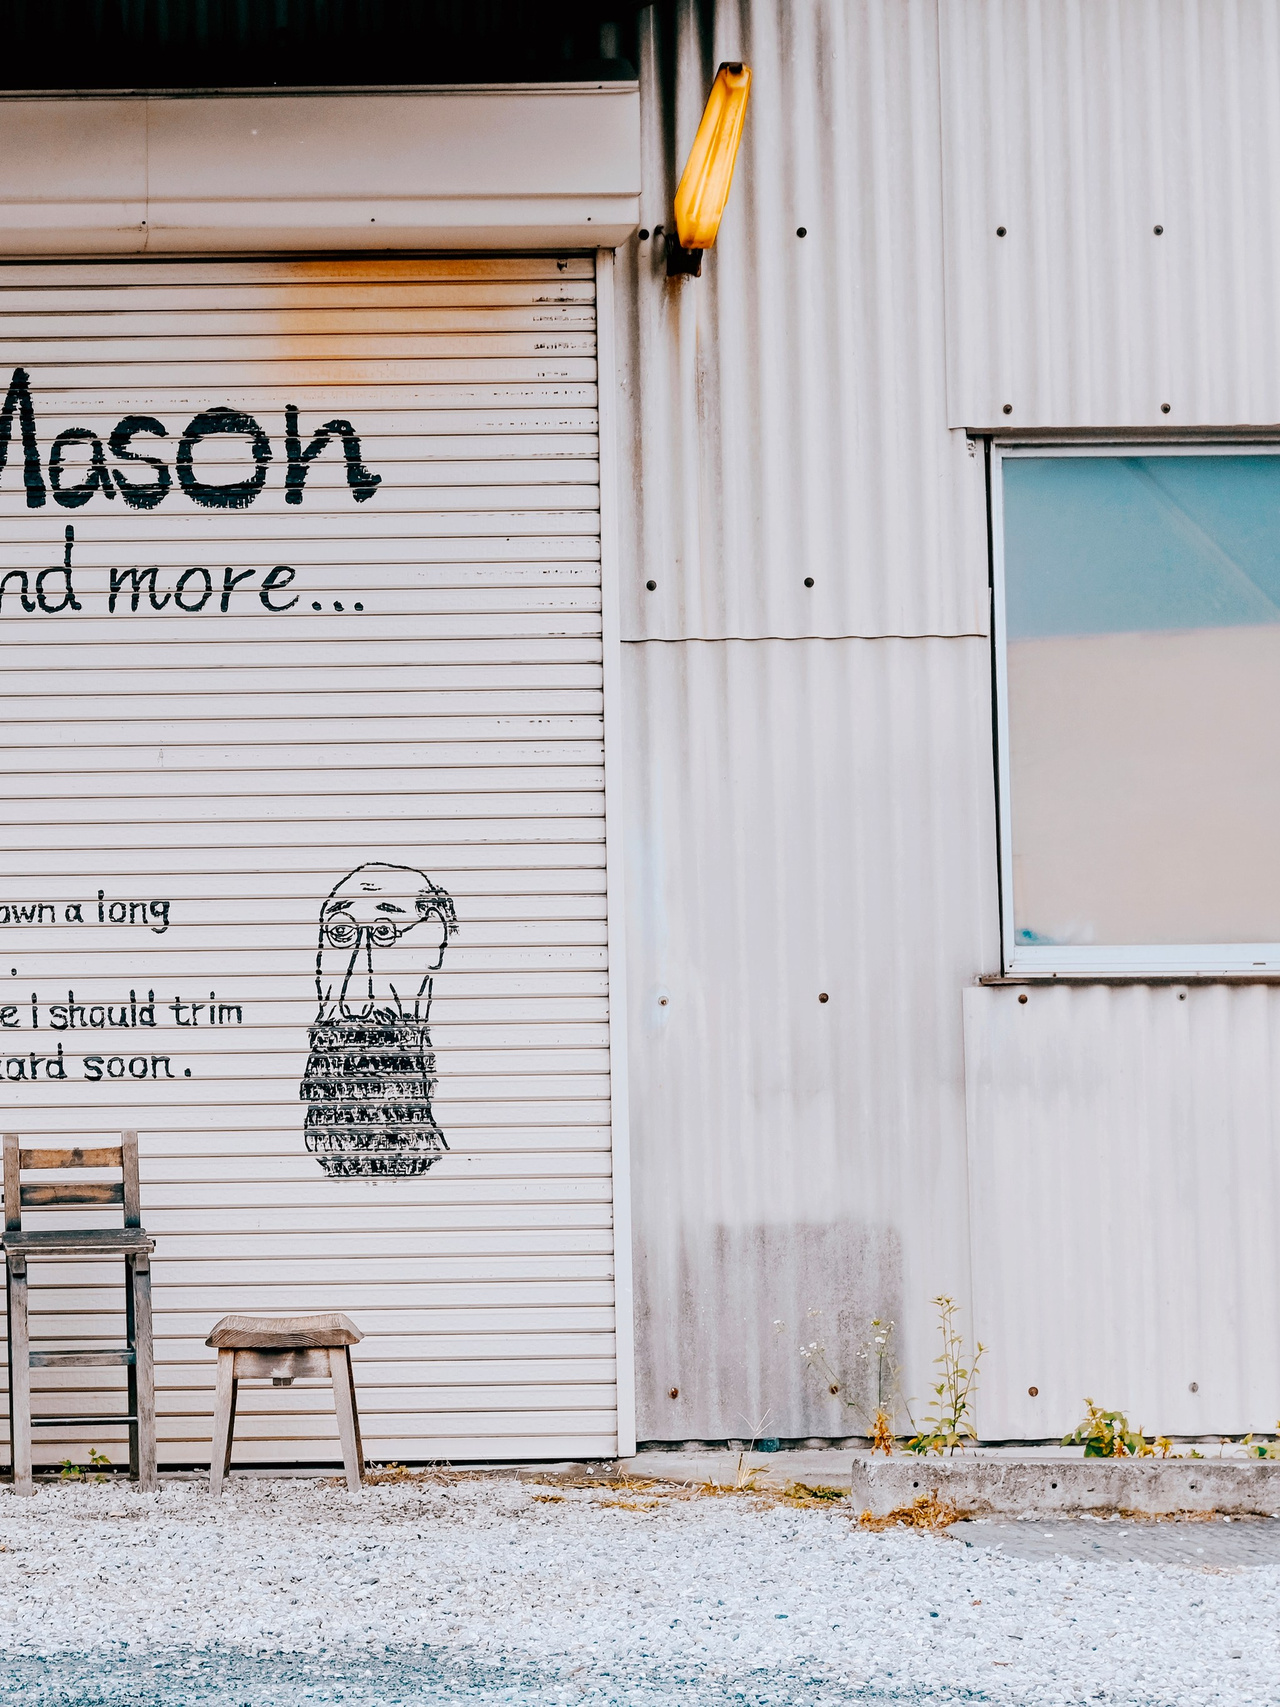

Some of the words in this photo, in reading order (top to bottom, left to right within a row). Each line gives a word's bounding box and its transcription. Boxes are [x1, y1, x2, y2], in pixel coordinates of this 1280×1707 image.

[108, 564, 364, 614] more...
[64, 903, 84, 923] a
[97, 889, 170, 934] long
[49, 989, 157, 1031] should
[169, 991, 243, 1026] trim
